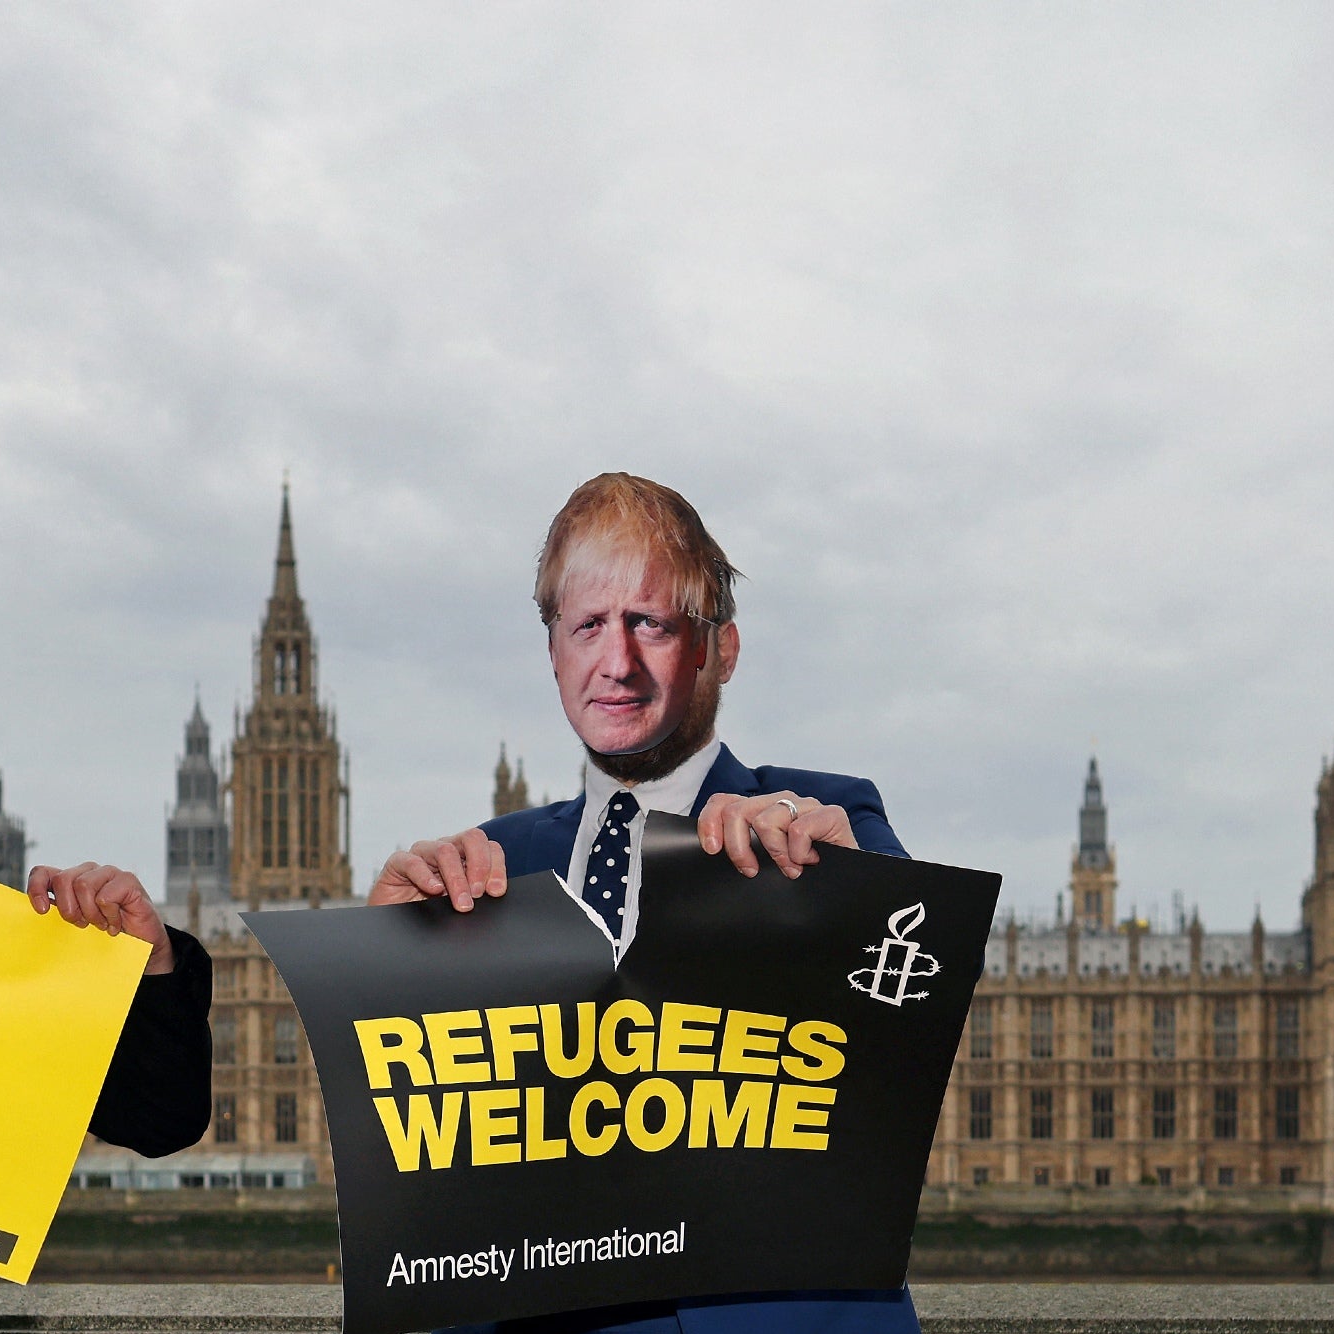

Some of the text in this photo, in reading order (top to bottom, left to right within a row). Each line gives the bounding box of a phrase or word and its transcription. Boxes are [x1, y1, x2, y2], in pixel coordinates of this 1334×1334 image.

[355, 999, 847, 1089] REFUGEES
[375, 1078, 837, 1171] WELCOME
[387, 1222, 685, 1287] Amnesty International
